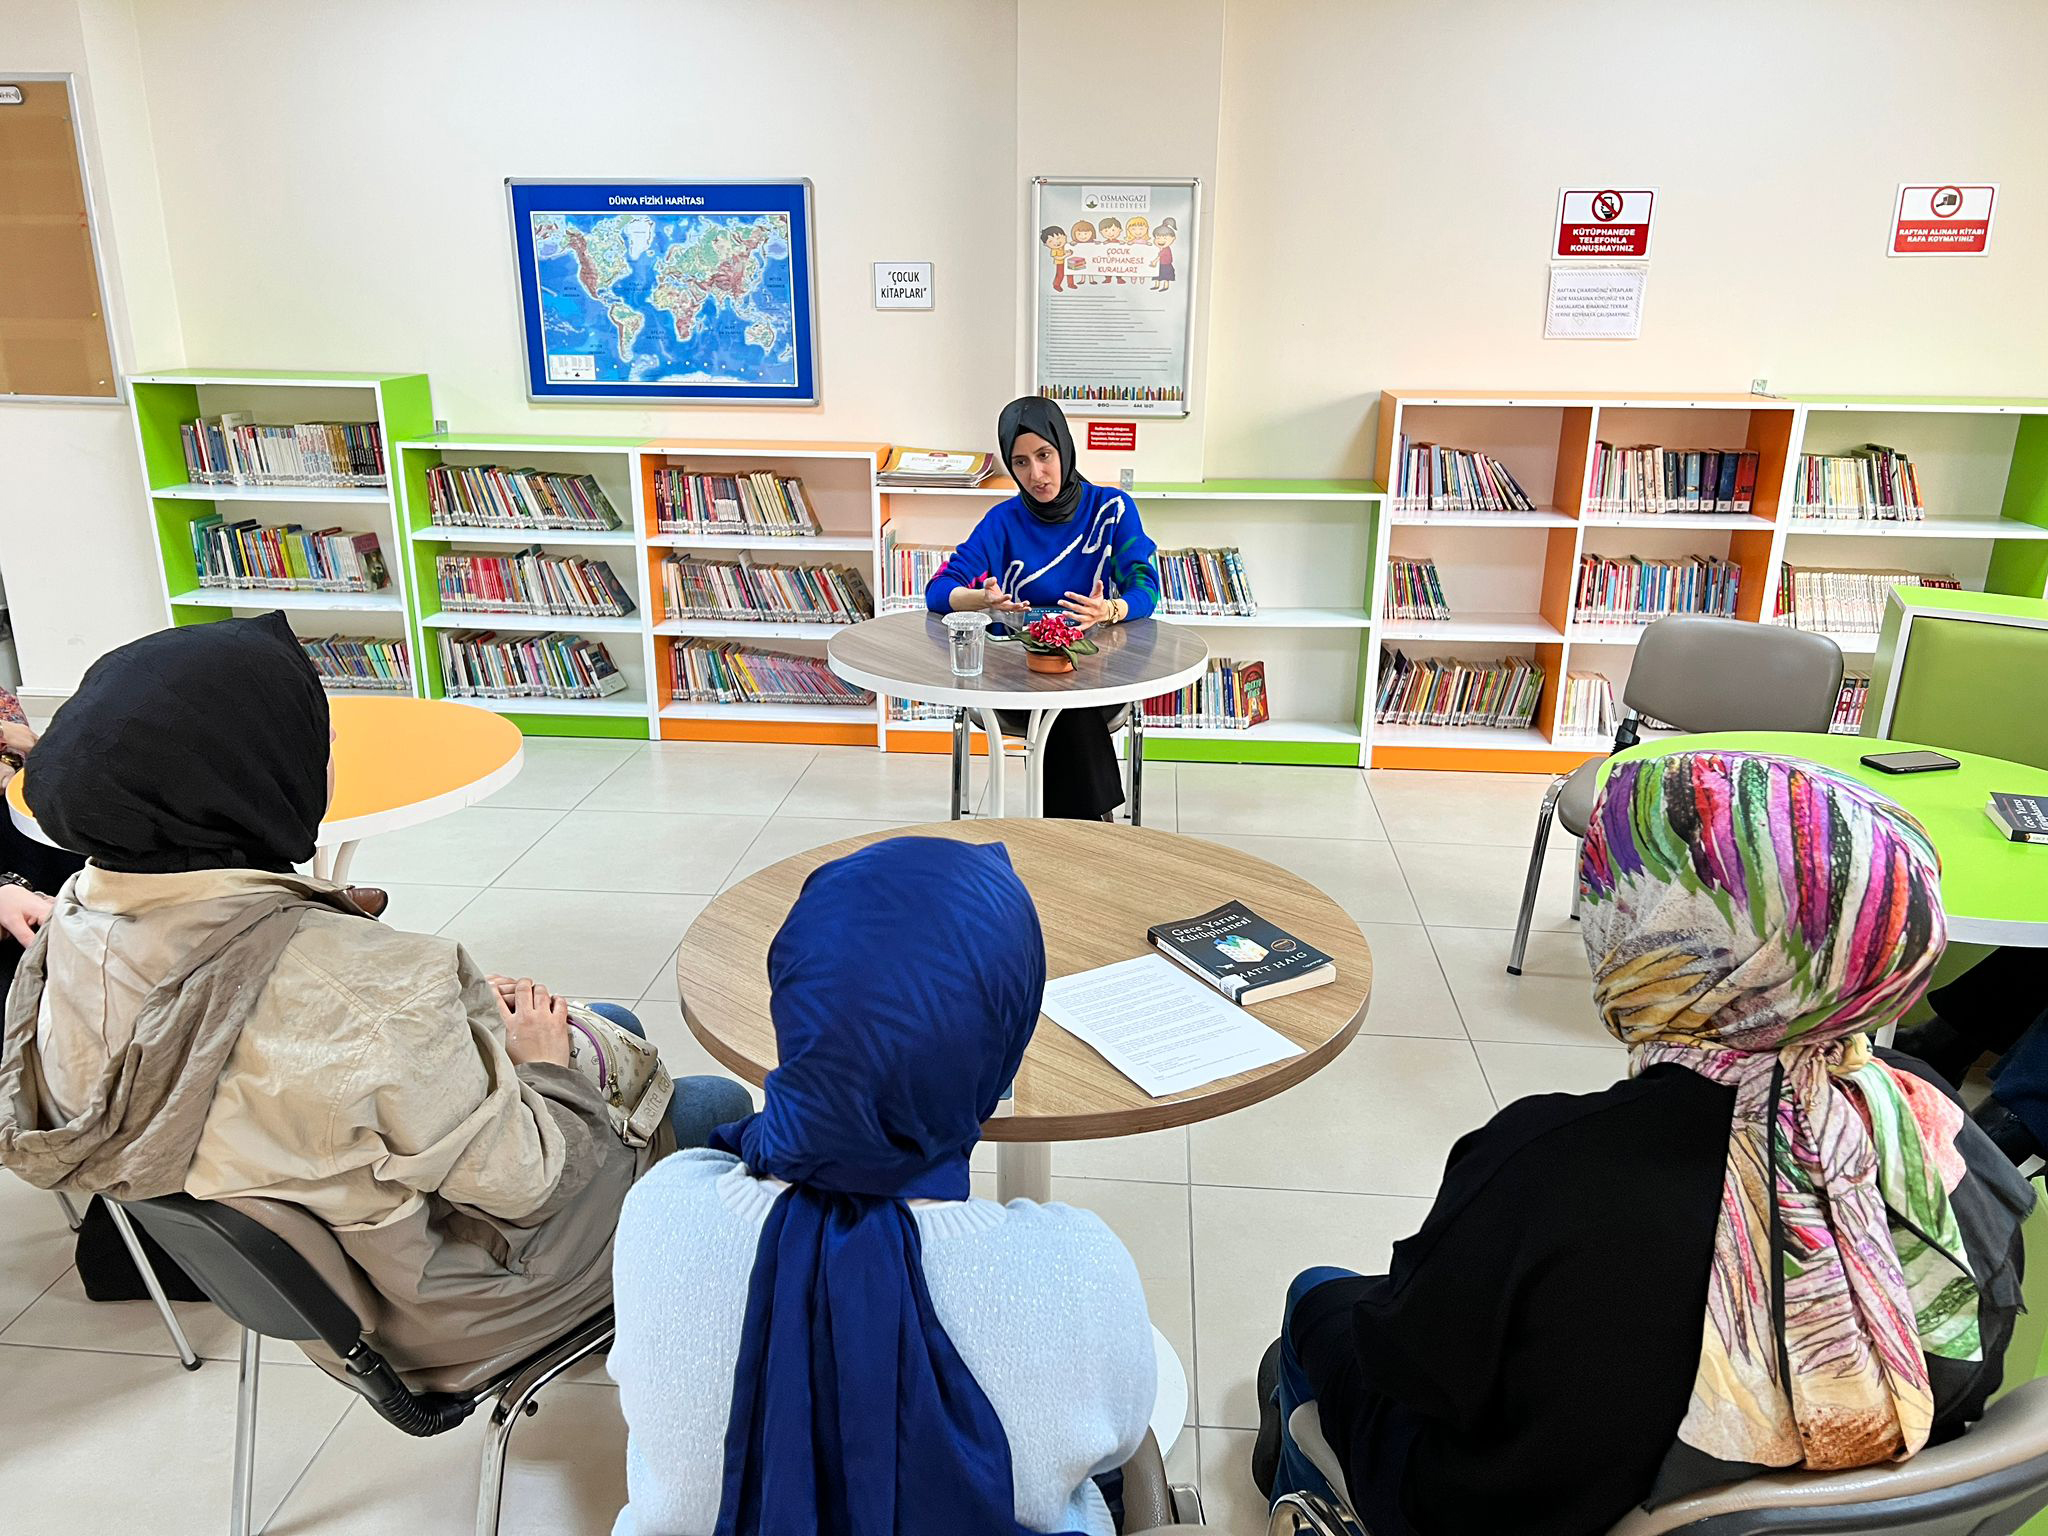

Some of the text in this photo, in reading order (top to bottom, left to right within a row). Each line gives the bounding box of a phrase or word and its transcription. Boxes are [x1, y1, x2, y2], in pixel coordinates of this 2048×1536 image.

[608, 195, 705, 206] DÜNYA FİZİKİ HARİTASI
[1573, 228, 1636, 236] KÜTÜPHANEDE
[1899, 227, 1985, 236] RAFTAN ALINAN KİTABI
[1106, 247, 1131, 256] ÇOCUK
[1570, 244, 1634, 253] KONUŞMAYINIZ
[1097, 266, 1138, 274] KURALLARI
[1171, 925, 1203, 936] Gece
[1201, 913, 1240, 928] Yarısı
[1175, 916, 1252, 943] Kütüphanesi
[1272, 951, 1308, 969] HAIG
